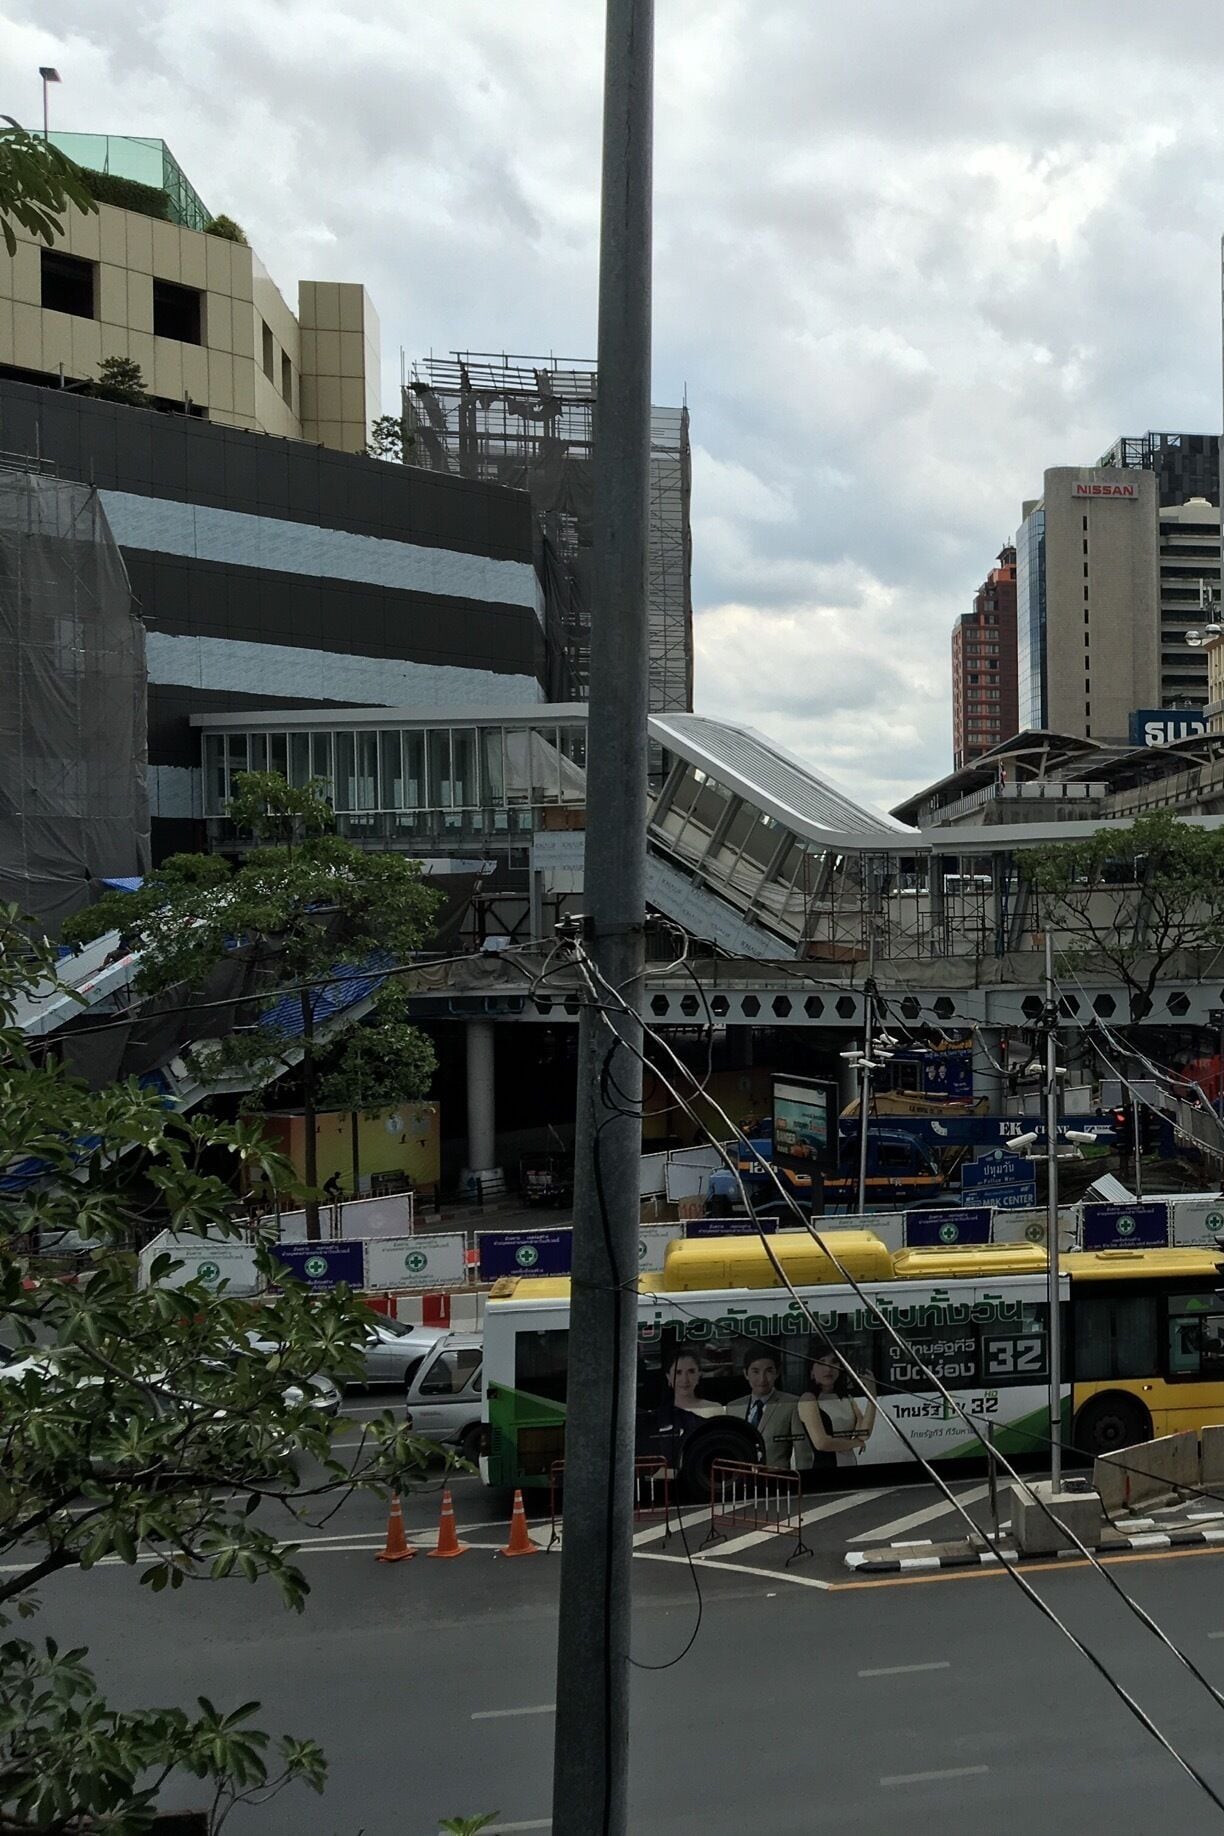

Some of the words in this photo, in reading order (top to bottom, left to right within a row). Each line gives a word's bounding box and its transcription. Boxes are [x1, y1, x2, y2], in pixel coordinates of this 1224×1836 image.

[1076, 483, 1135, 497] NISSAN
[999, 1121, 1023, 1136] EK
[984, 1161, 1015, 1178] ปทุมวัน
[1003, 1194, 1034, 1206] CENTER
[989, 1338, 1042, 1373] 32
[971, 1397, 998, 1414] 32
